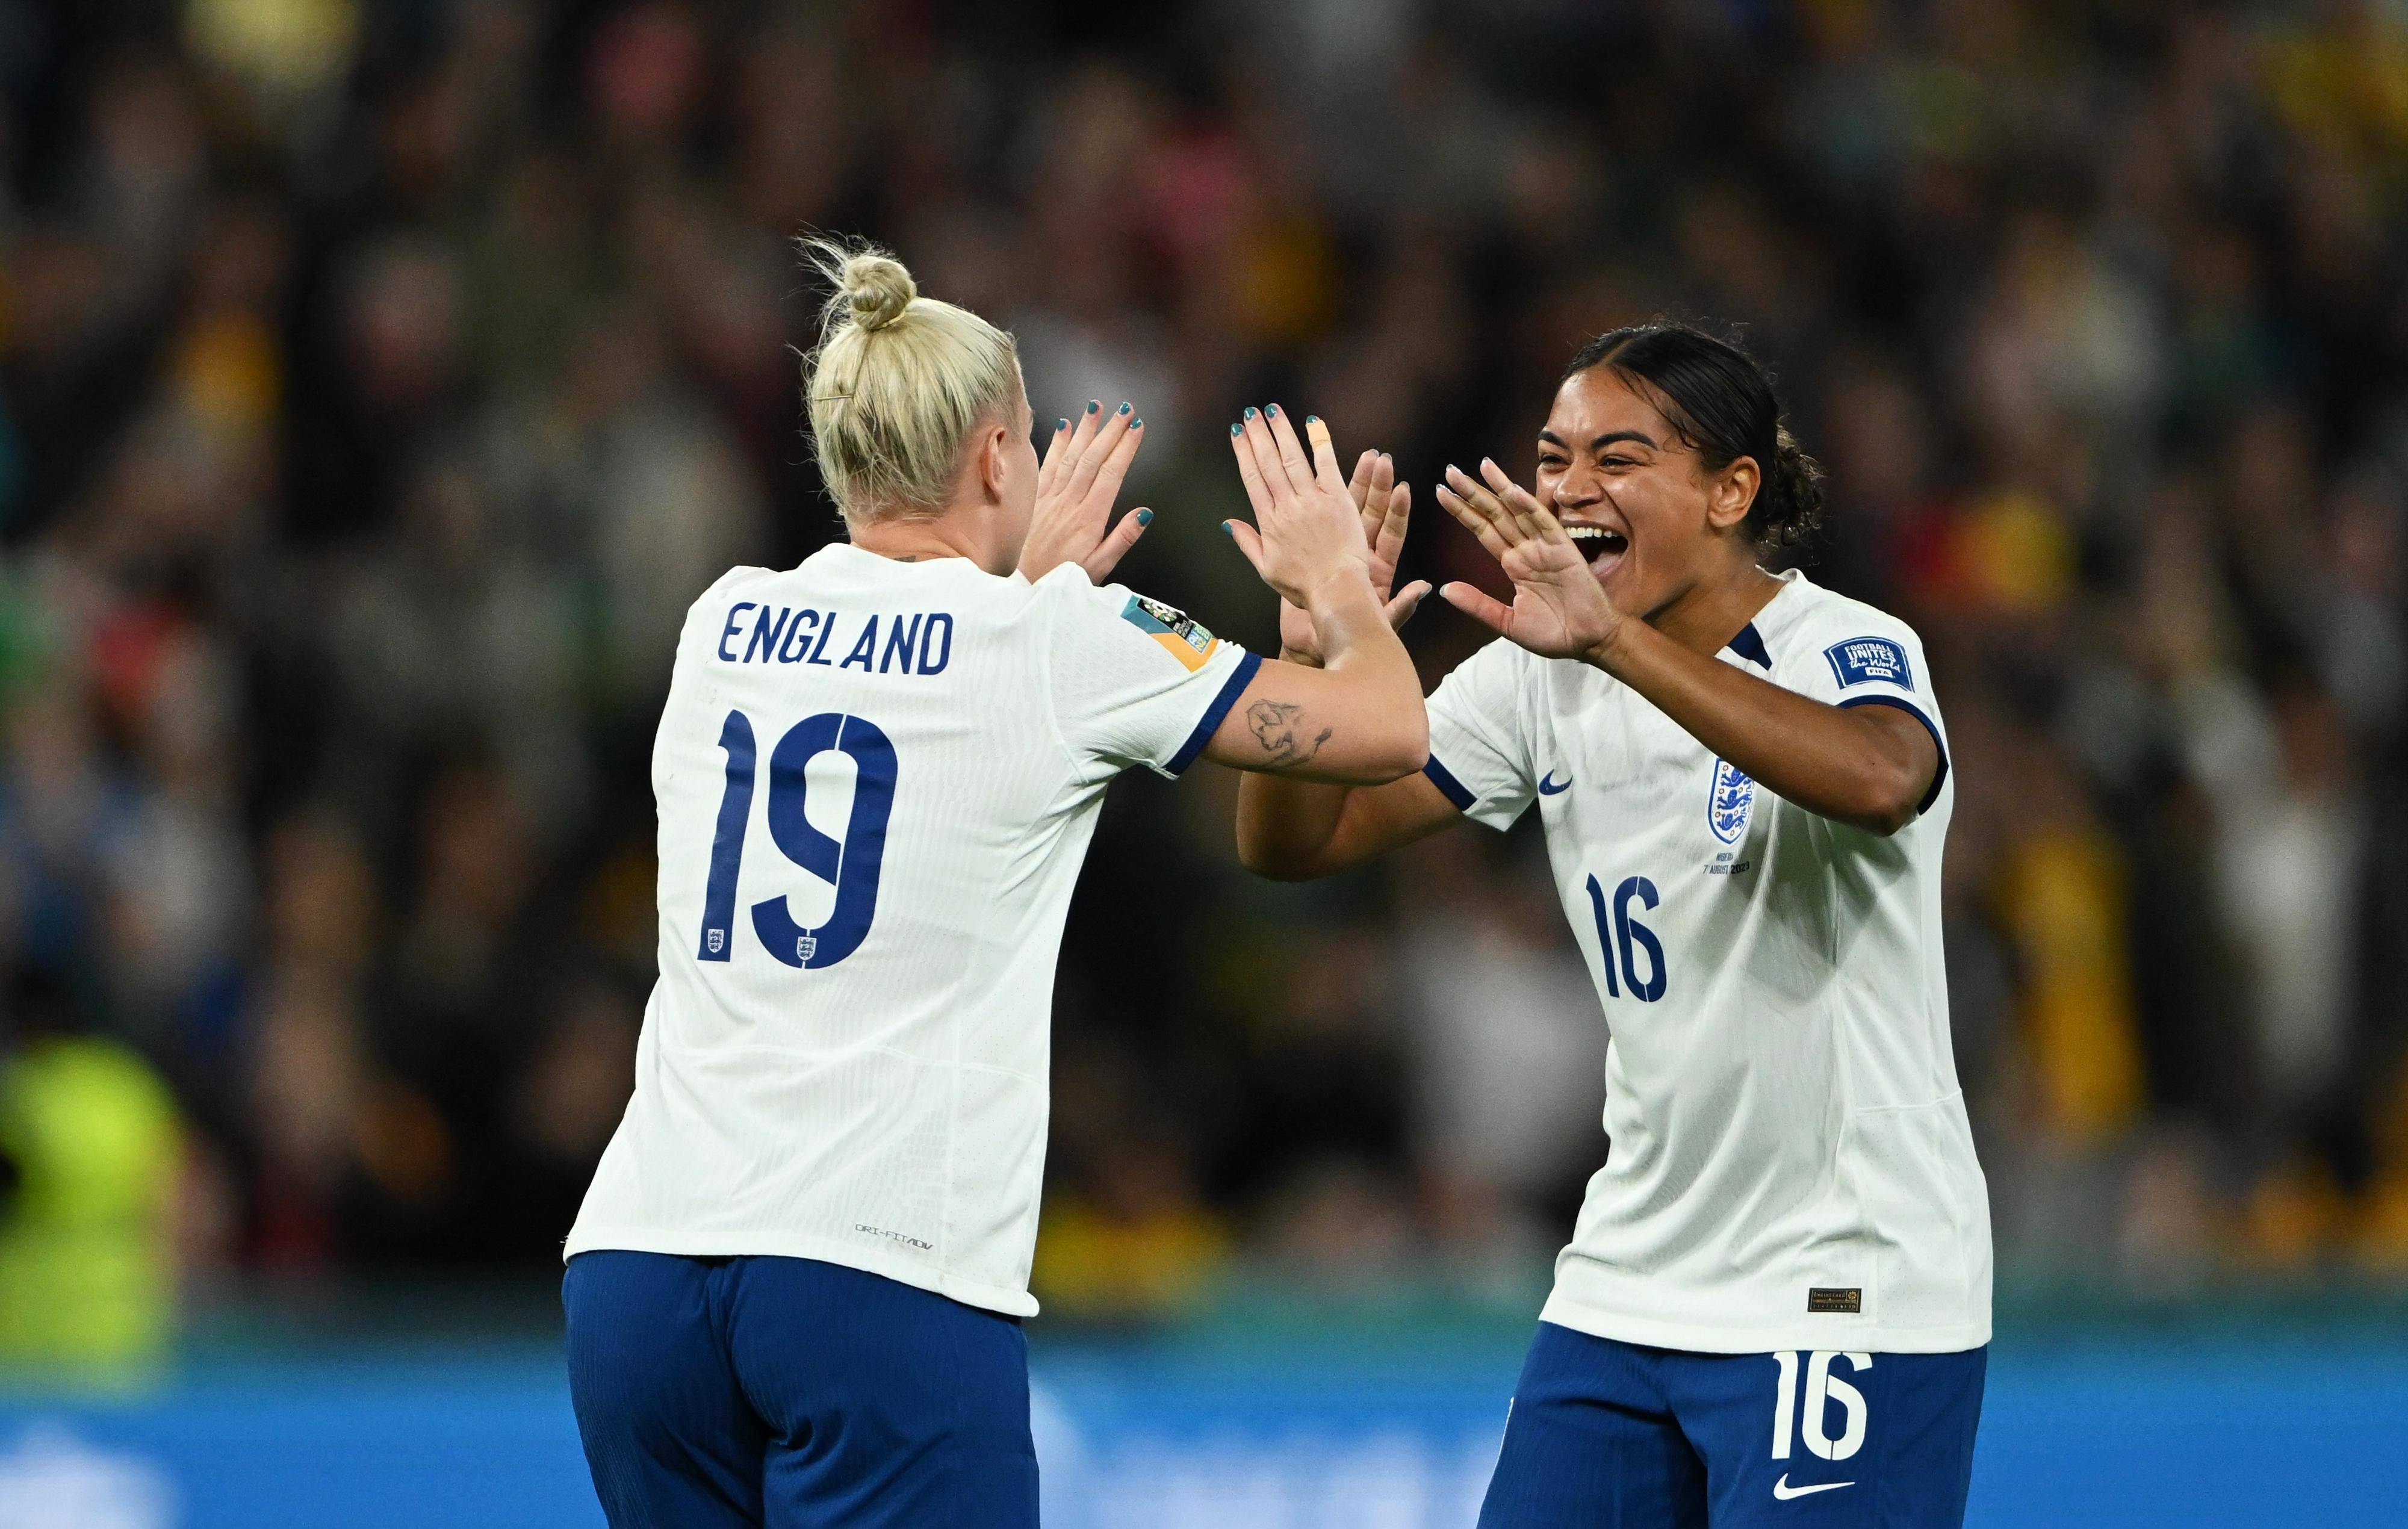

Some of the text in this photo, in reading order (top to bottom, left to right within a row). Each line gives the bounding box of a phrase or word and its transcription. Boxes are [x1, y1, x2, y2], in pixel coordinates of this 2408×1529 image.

[718, 602, 953, 675] ENGLAND
[1845, 644, 1893, 653] FOOTBALL
[1848, 649, 1896, 662] UNITES
[1848, 658, 1900, 673] the World
[697, 710, 898, 969] 19
[1703, 865, 1708, 874] 7
[1710, 865, 1729, 874] AUGUST
[1586, 872, 1666, 1002] 16
[1772, 1350, 1872, 1460] 16
